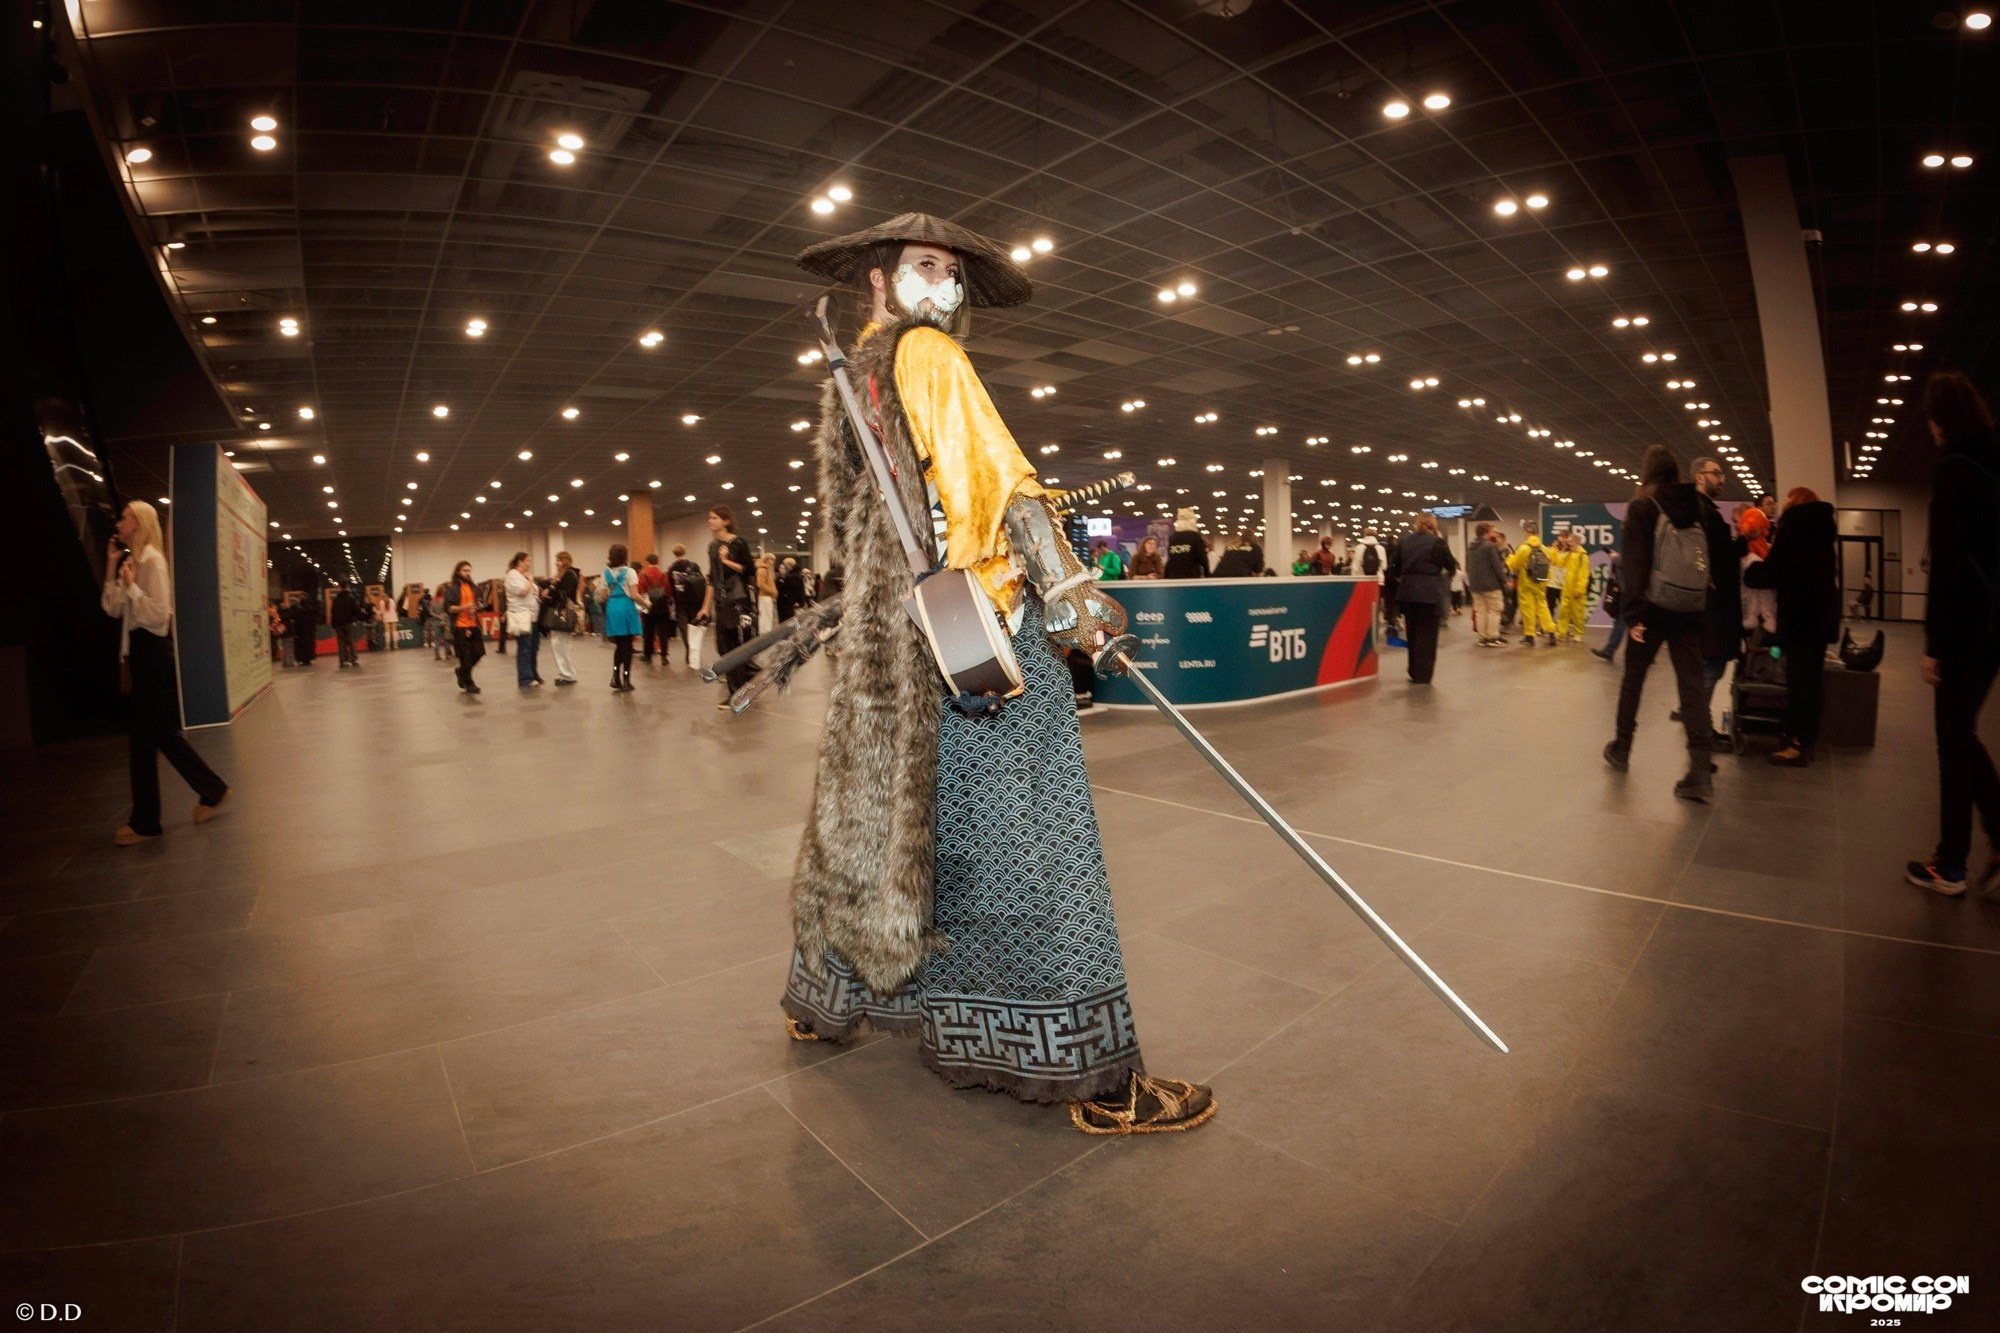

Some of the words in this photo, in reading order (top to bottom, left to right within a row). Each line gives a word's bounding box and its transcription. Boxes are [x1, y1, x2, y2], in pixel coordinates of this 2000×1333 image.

[1571, 524, 1615, 546] ВТБ
[1135, 611, 1165, 622] deep
[1269, 628, 1307, 663] ВТБ
[1178, 659, 1216, 669] LENTA.RU
